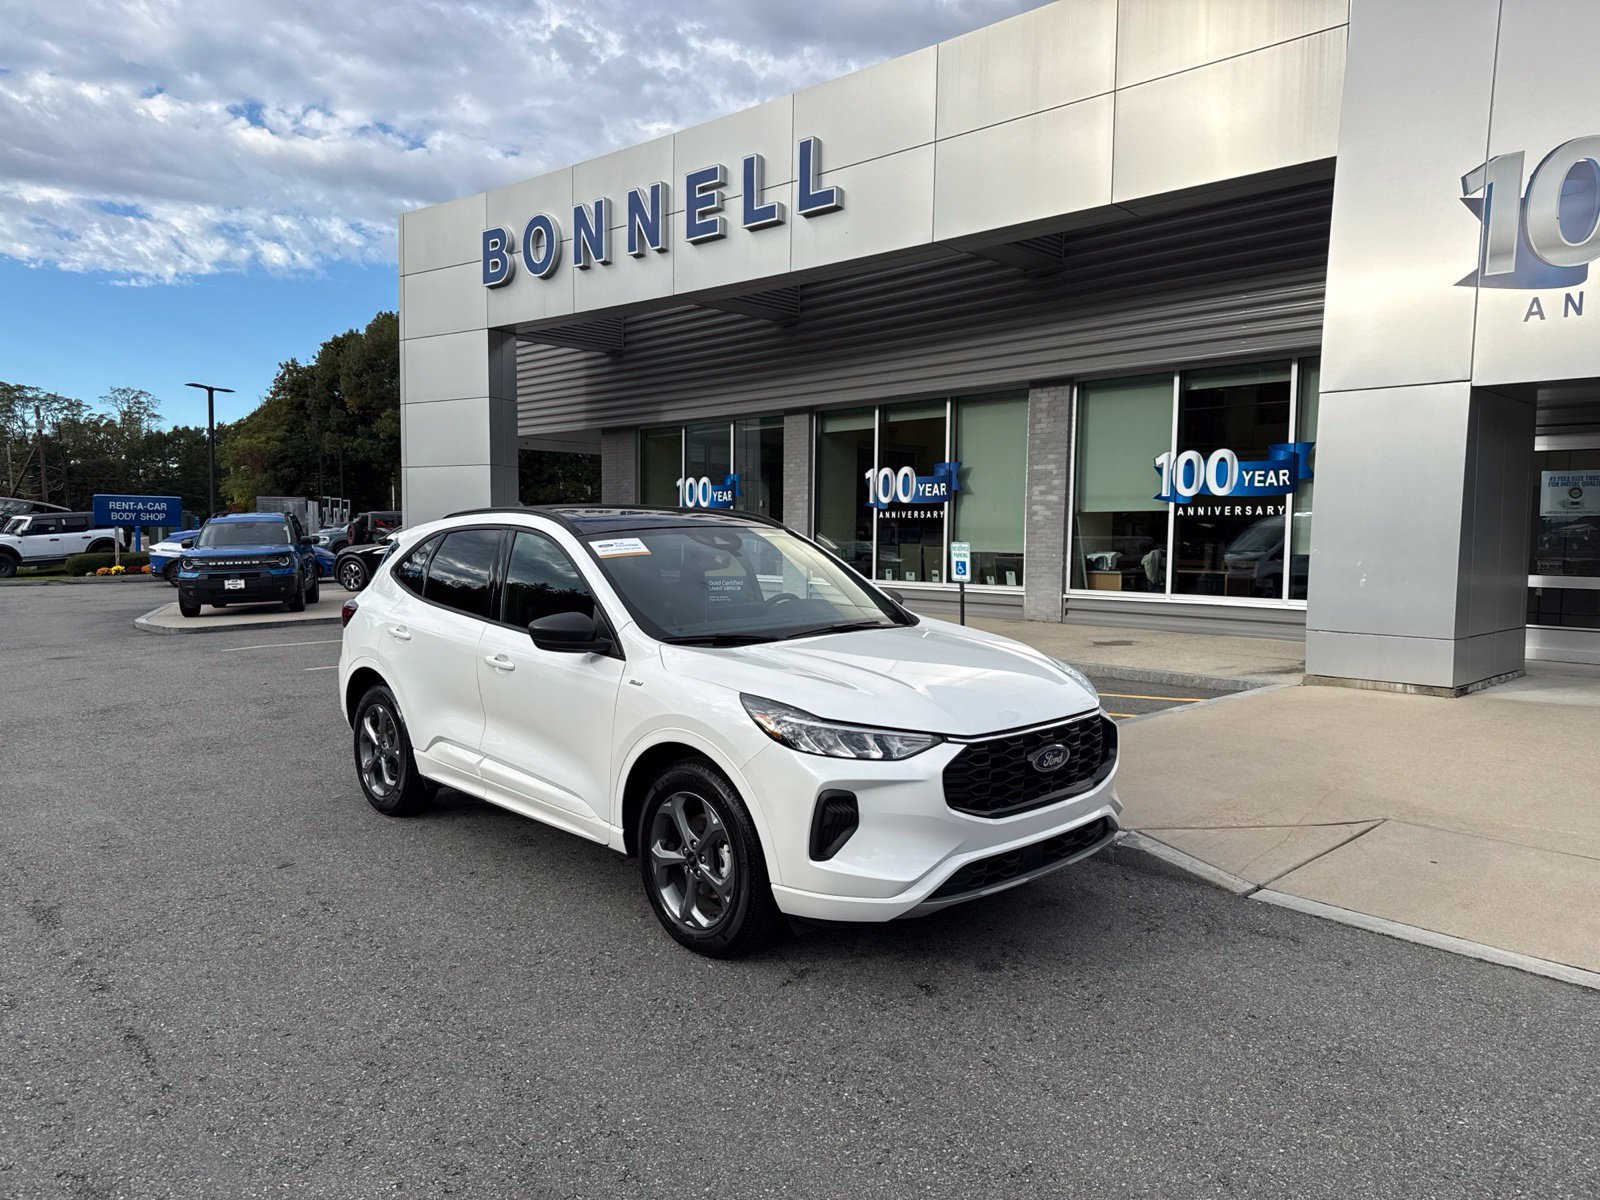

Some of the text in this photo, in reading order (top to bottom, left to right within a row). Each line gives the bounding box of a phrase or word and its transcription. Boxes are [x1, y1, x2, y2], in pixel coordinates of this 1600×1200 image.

[482, 136, 843, 288] BONNELL
[1154, 448, 1290, 497] 100 YEAR
[676, 476, 733, 508] 100 YEAR
[865, 466, 947, 504] 100 YEAR
[109, 501, 167, 511] RENT-A-CAR
[879, 510, 945, 519] ANNIVERSARY
[1177, 505, 1286, 516] ANNIVERSARY
[110, 511, 166, 521] BODY SHOP
[1043, 750, 1064, 767] Ford
